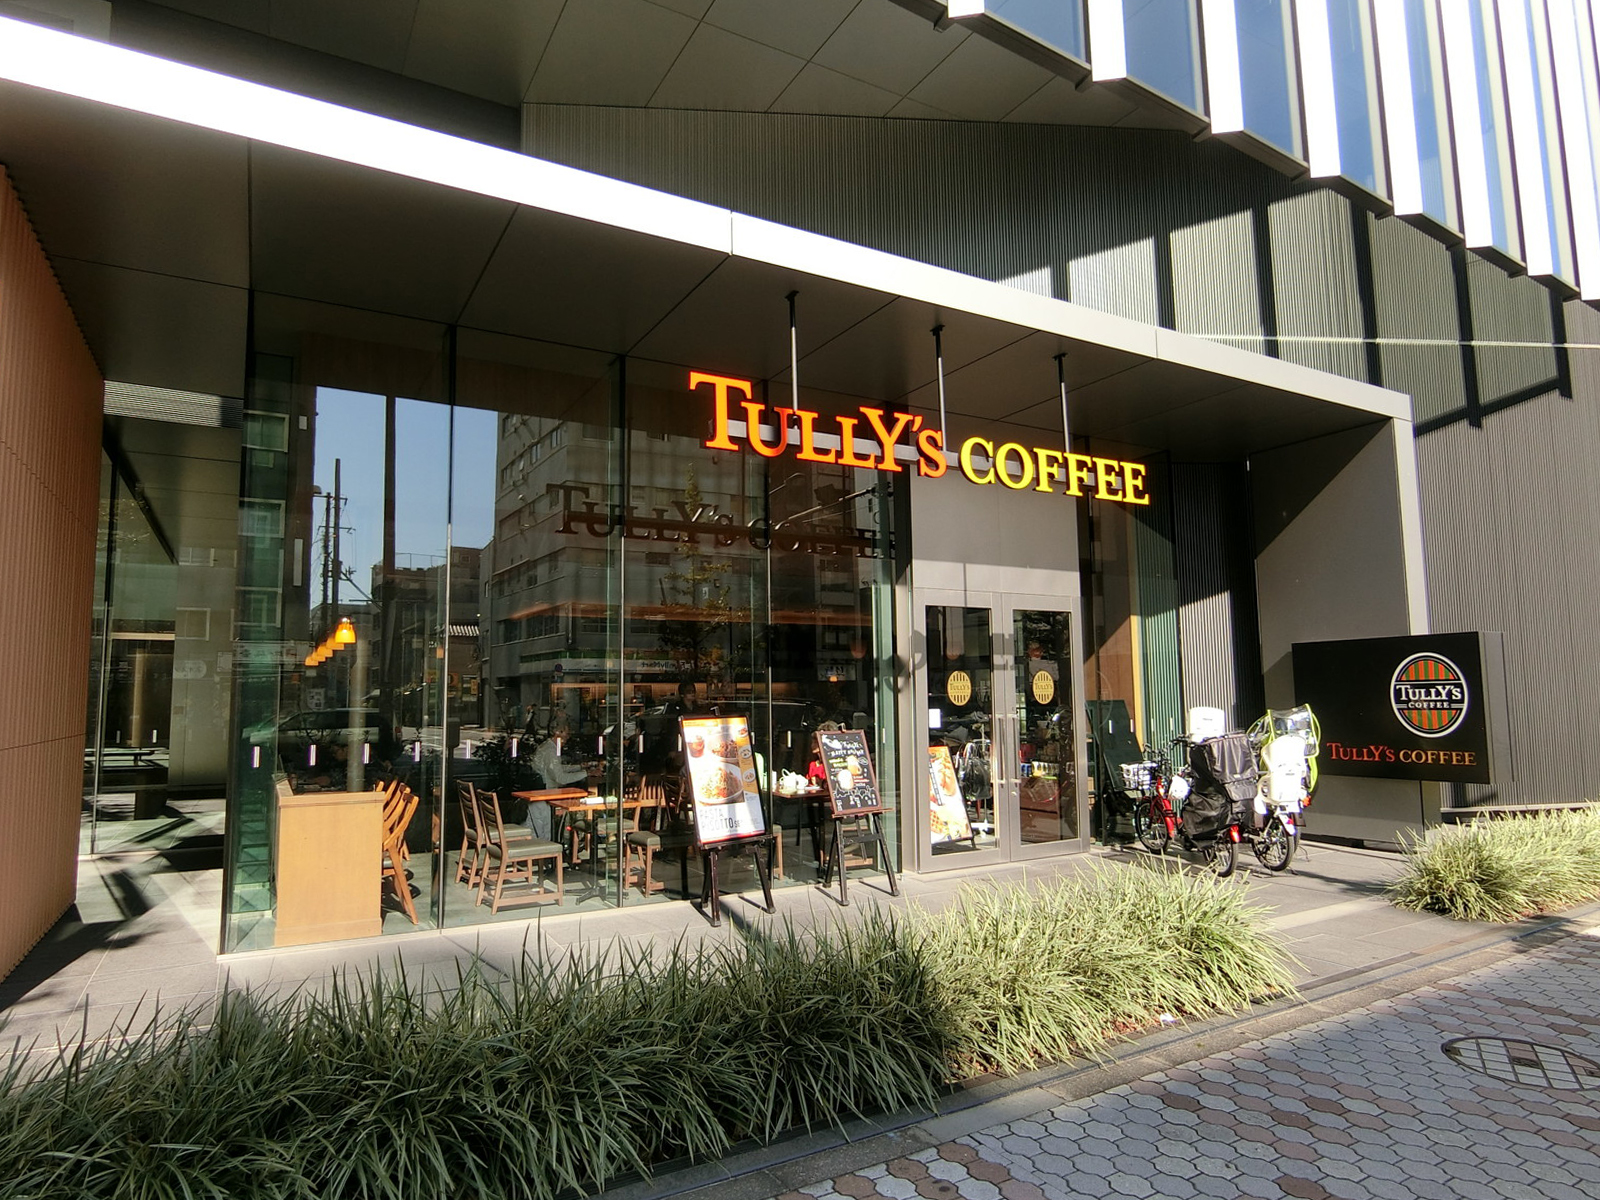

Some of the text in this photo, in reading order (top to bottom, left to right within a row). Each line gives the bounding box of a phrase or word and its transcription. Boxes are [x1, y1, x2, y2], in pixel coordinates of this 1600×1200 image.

[689, 371, 1150, 506] TULLY'S COFFEE
[1396, 684, 1462, 701] TULLY'S
[1408, 701, 1450, 709] COFFEE
[1326, 742, 1477, 766] TULLY'S COFFEE
